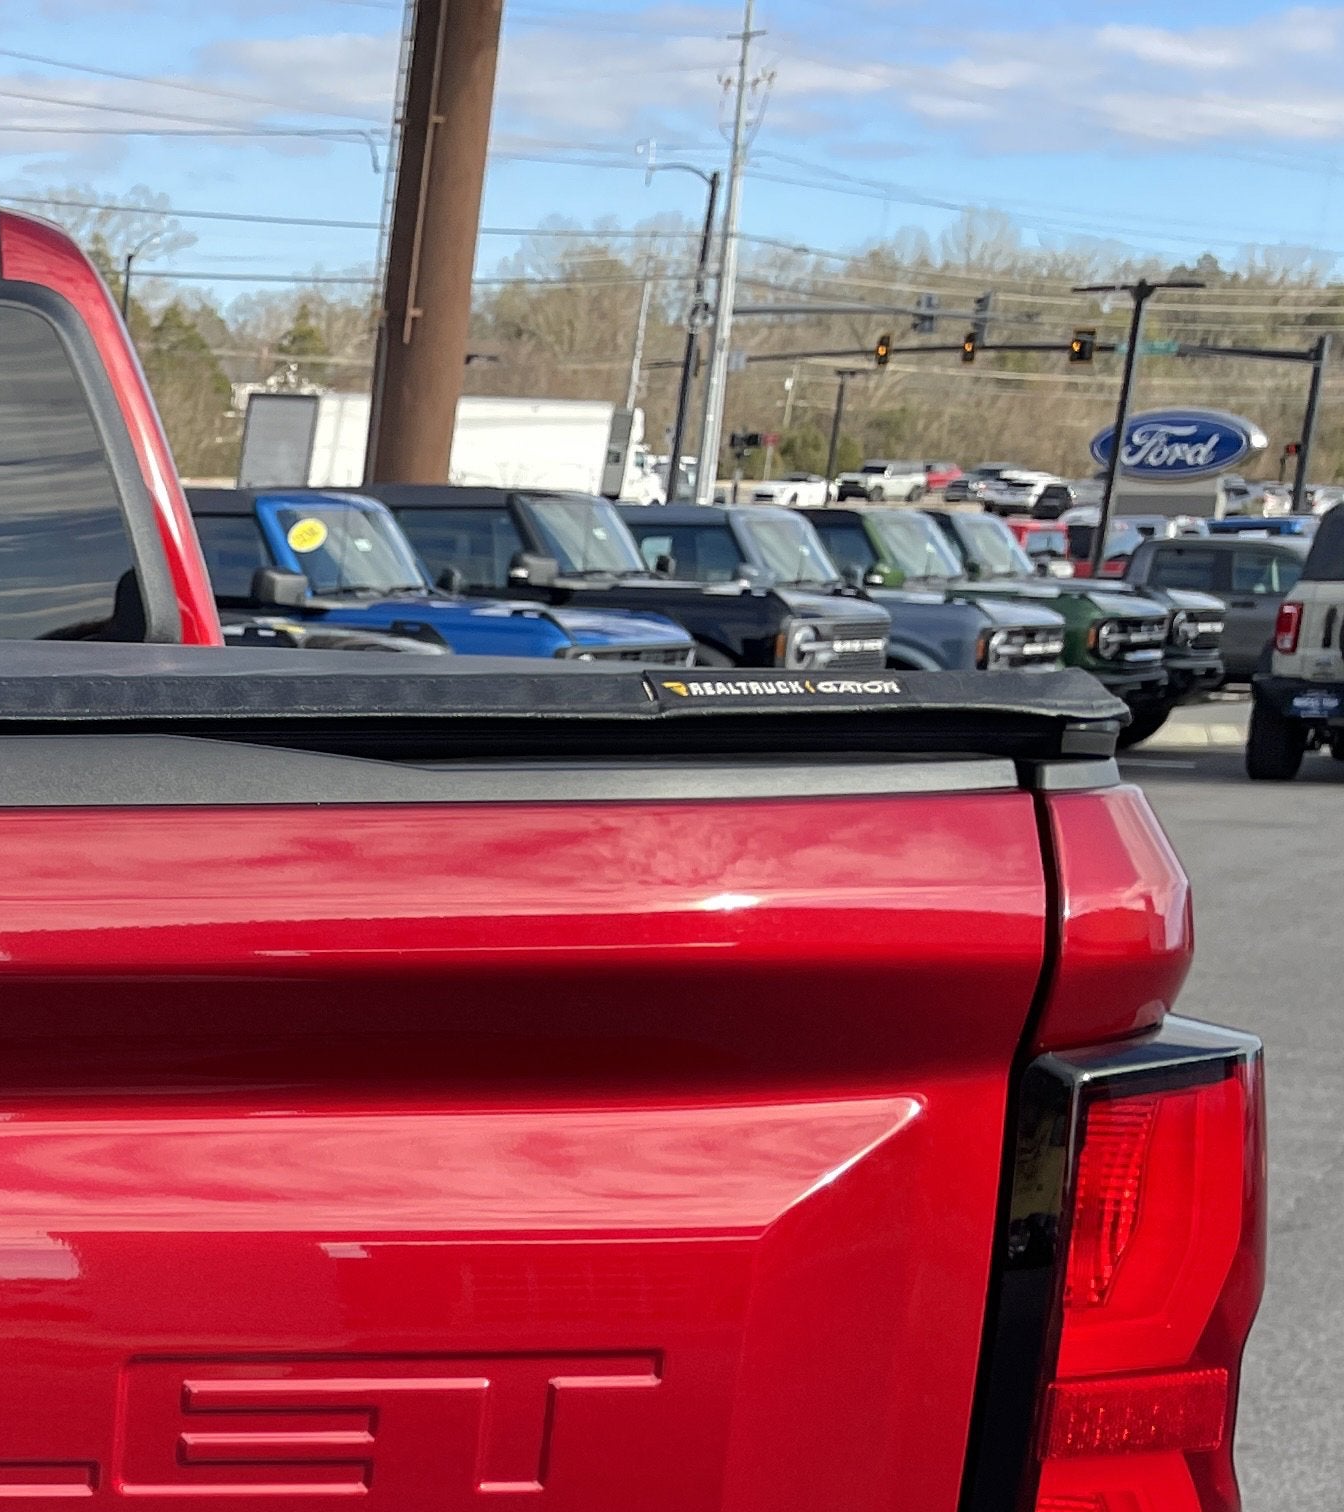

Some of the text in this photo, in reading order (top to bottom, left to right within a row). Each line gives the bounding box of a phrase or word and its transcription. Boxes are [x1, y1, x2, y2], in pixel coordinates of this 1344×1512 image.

[1119, 424, 1220, 467] Ford
[687, 679, 902, 696] REALTRUCK GATOR
